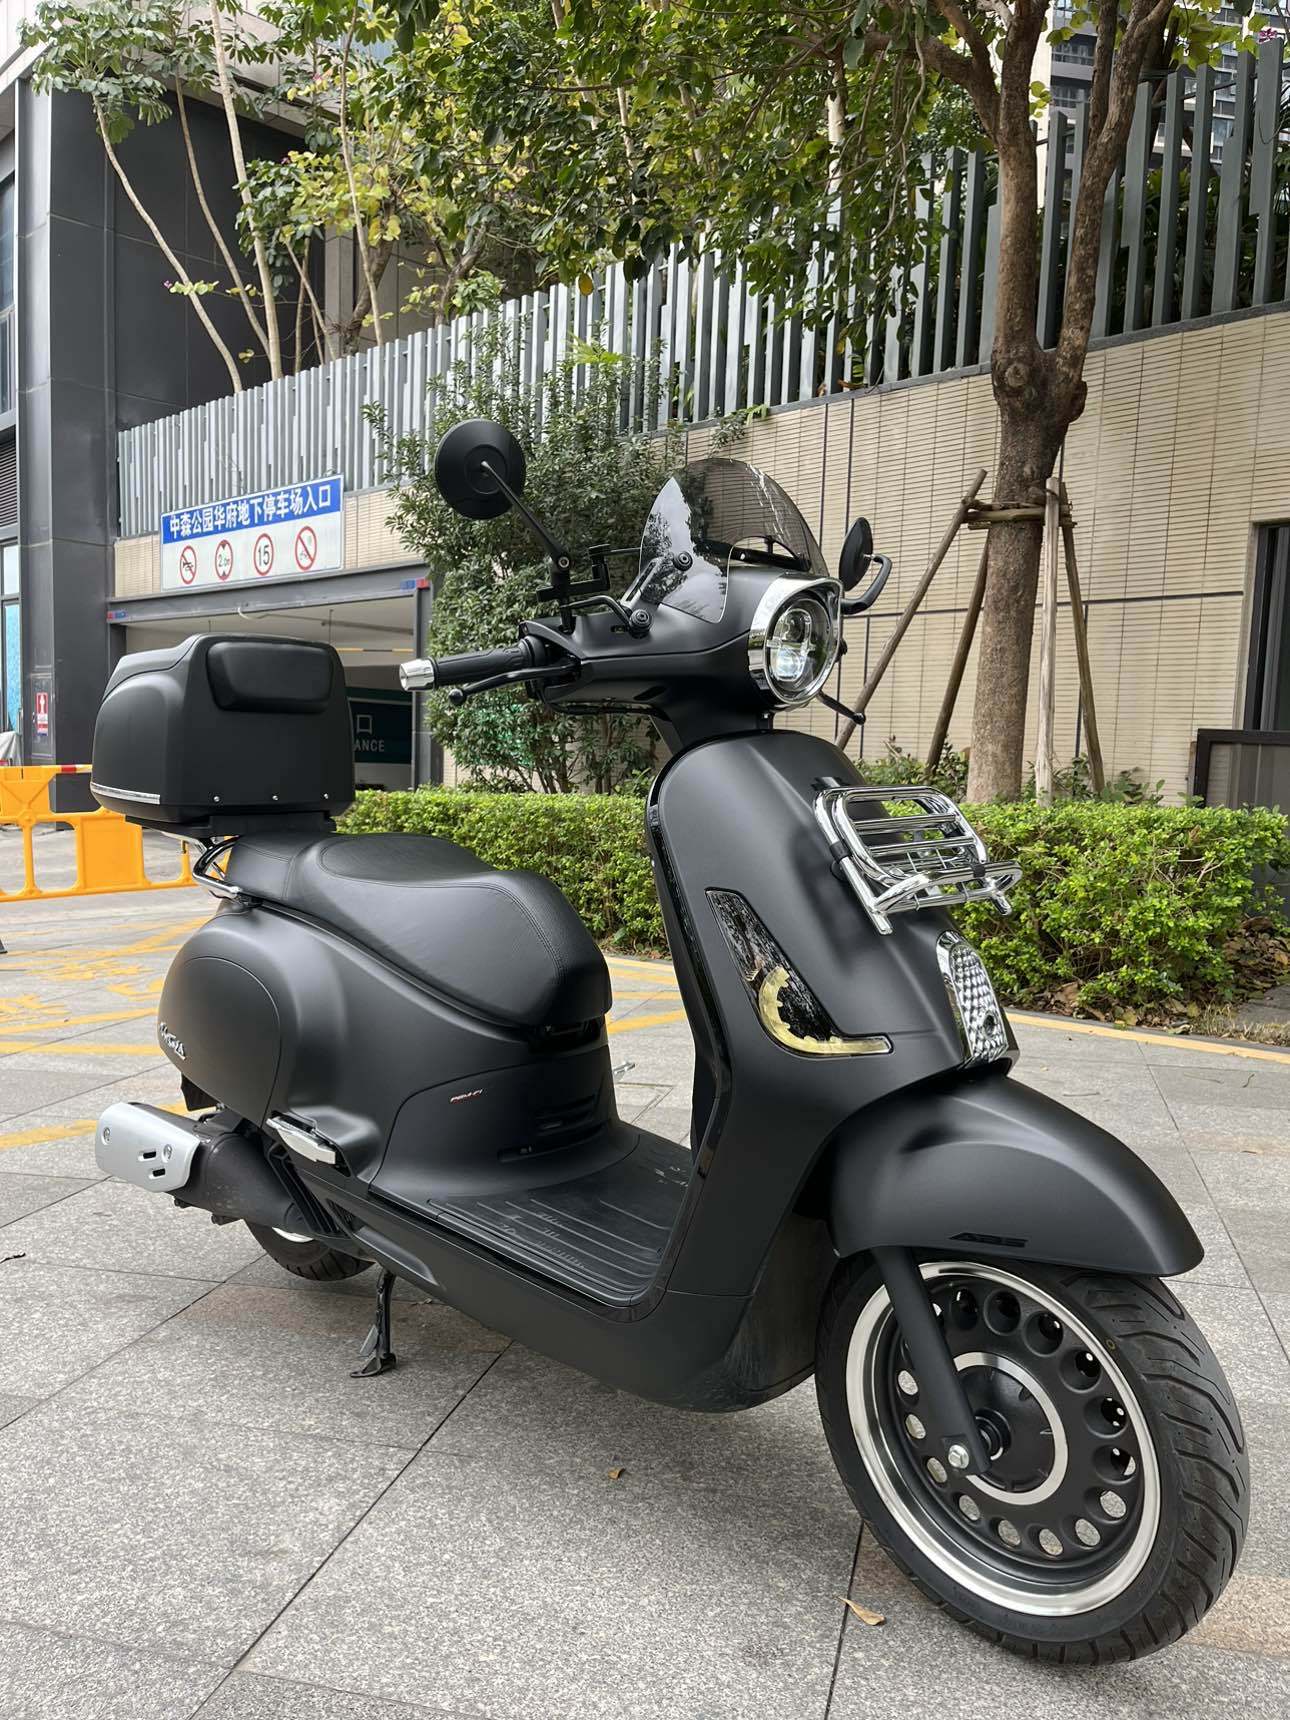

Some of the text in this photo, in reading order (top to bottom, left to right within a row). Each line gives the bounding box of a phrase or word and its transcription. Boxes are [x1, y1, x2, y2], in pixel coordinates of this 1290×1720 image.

[169, 484, 331, 540] 中森公园华府地下停车场入口
[257, 544, 270, 567] 15
